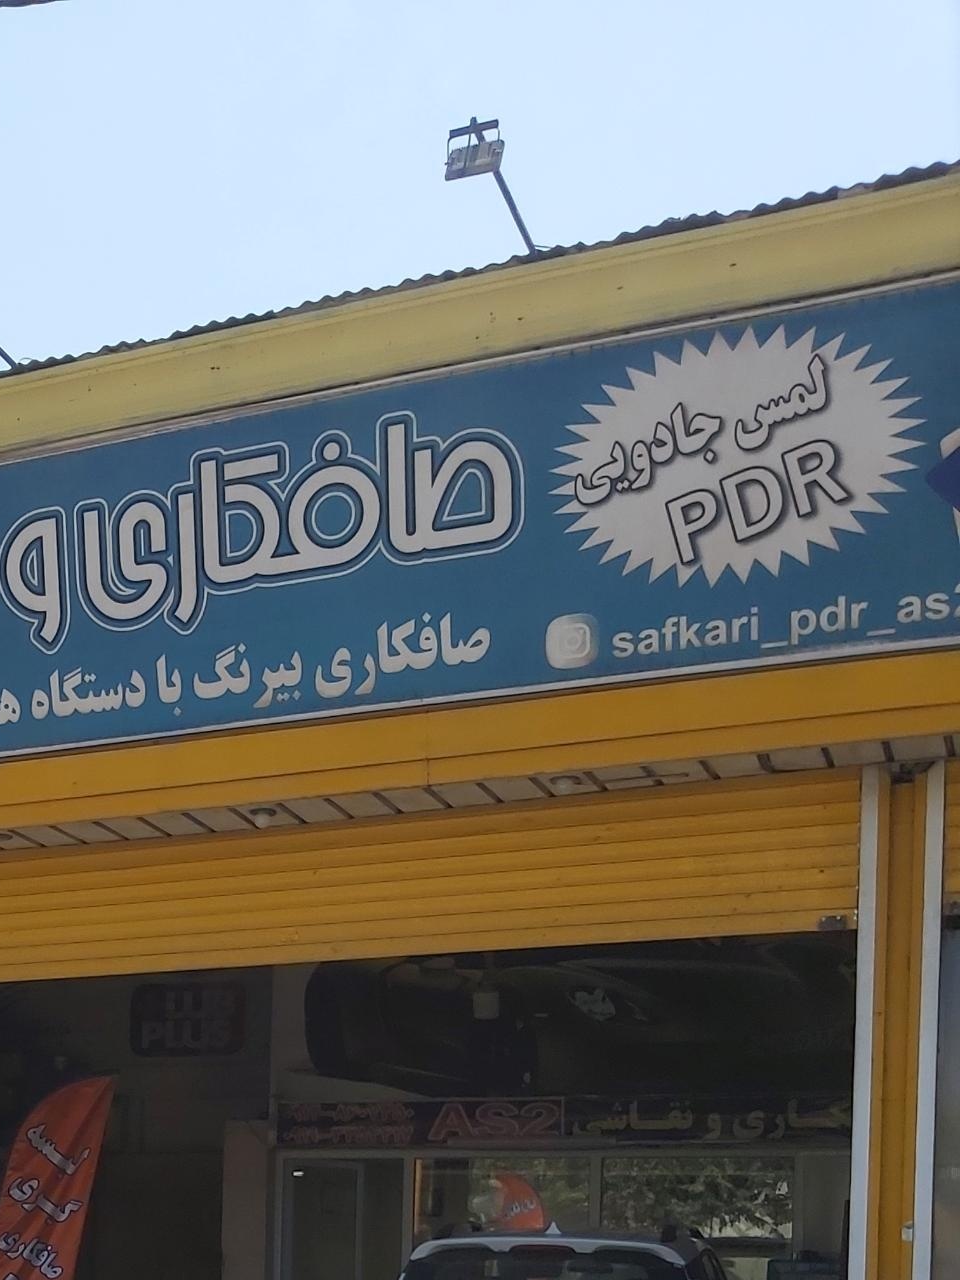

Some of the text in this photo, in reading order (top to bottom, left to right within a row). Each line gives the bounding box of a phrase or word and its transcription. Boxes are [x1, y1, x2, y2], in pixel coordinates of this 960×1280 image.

[574, 354, 830, 506] لمس جادویی
[78, 416, 517, 630] صافکاری
[665, 439, 850, 566] PDR
[2, 513, 64, 647] و
[30, 666, 146, 720] دستگاه
[155, 653, 183, 717] با
[315, 611, 492, 699] صافکاری
[426, 1100, 562, 1142] AS2
